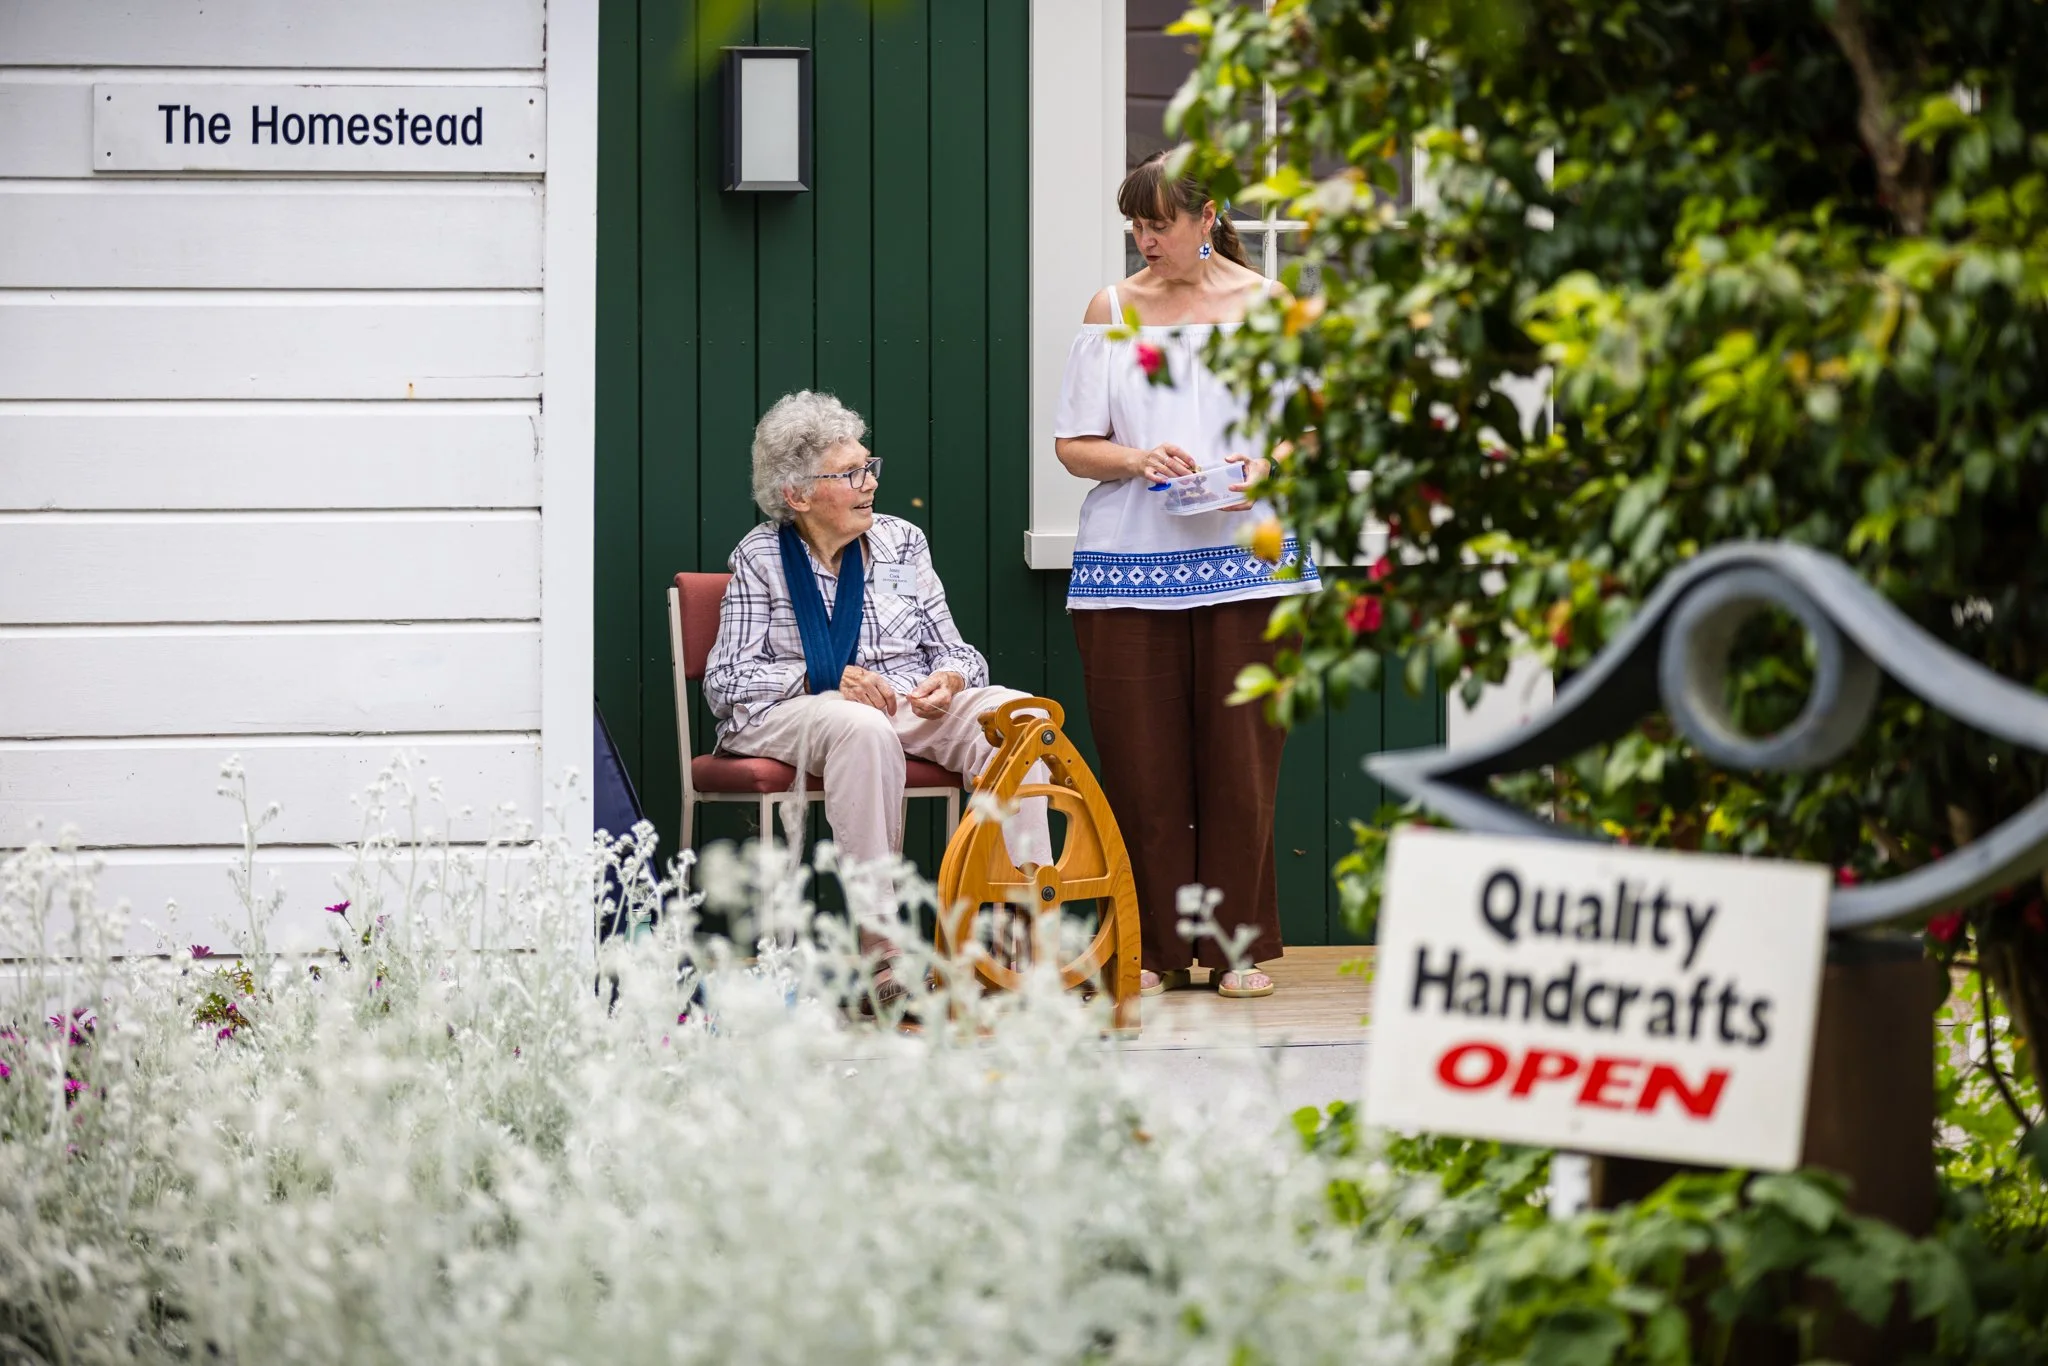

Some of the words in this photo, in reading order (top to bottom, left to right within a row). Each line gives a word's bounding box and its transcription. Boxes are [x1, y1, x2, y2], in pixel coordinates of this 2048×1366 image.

[158, 105, 231, 144] The
[252, 105, 483, 145] Homestead
[1480, 869, 1716, 969] Quality
[1410, 946, 1774, 1047] Handcrafts
[1434, 1040, 1732, 1121] OPEN
